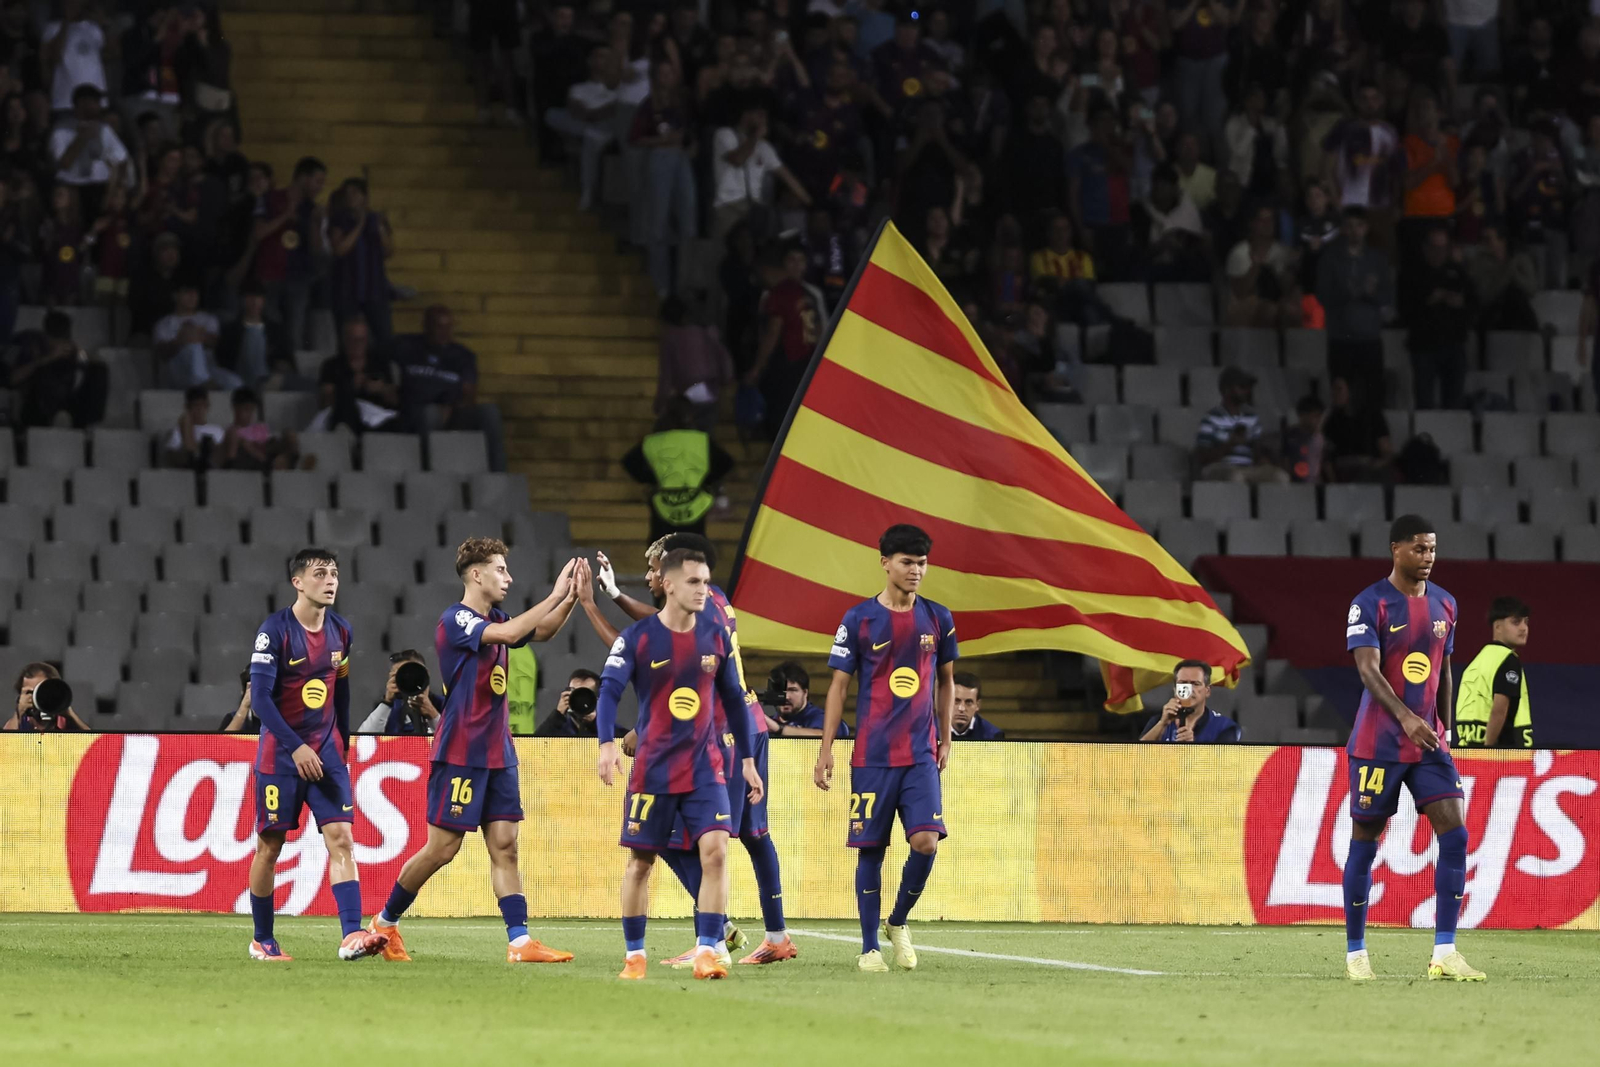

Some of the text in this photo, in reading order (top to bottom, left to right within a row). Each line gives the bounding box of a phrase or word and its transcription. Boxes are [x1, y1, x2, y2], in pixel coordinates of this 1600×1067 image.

[450, 776, 473, 804] 16
[1358, 765, 1385, 794] 14
[265, 784, 279, 811] 8
[630, 792, 655, 821] 17
[850, 792, 876, 819] 27
[1266, 748, 1598, 929] Lay's
